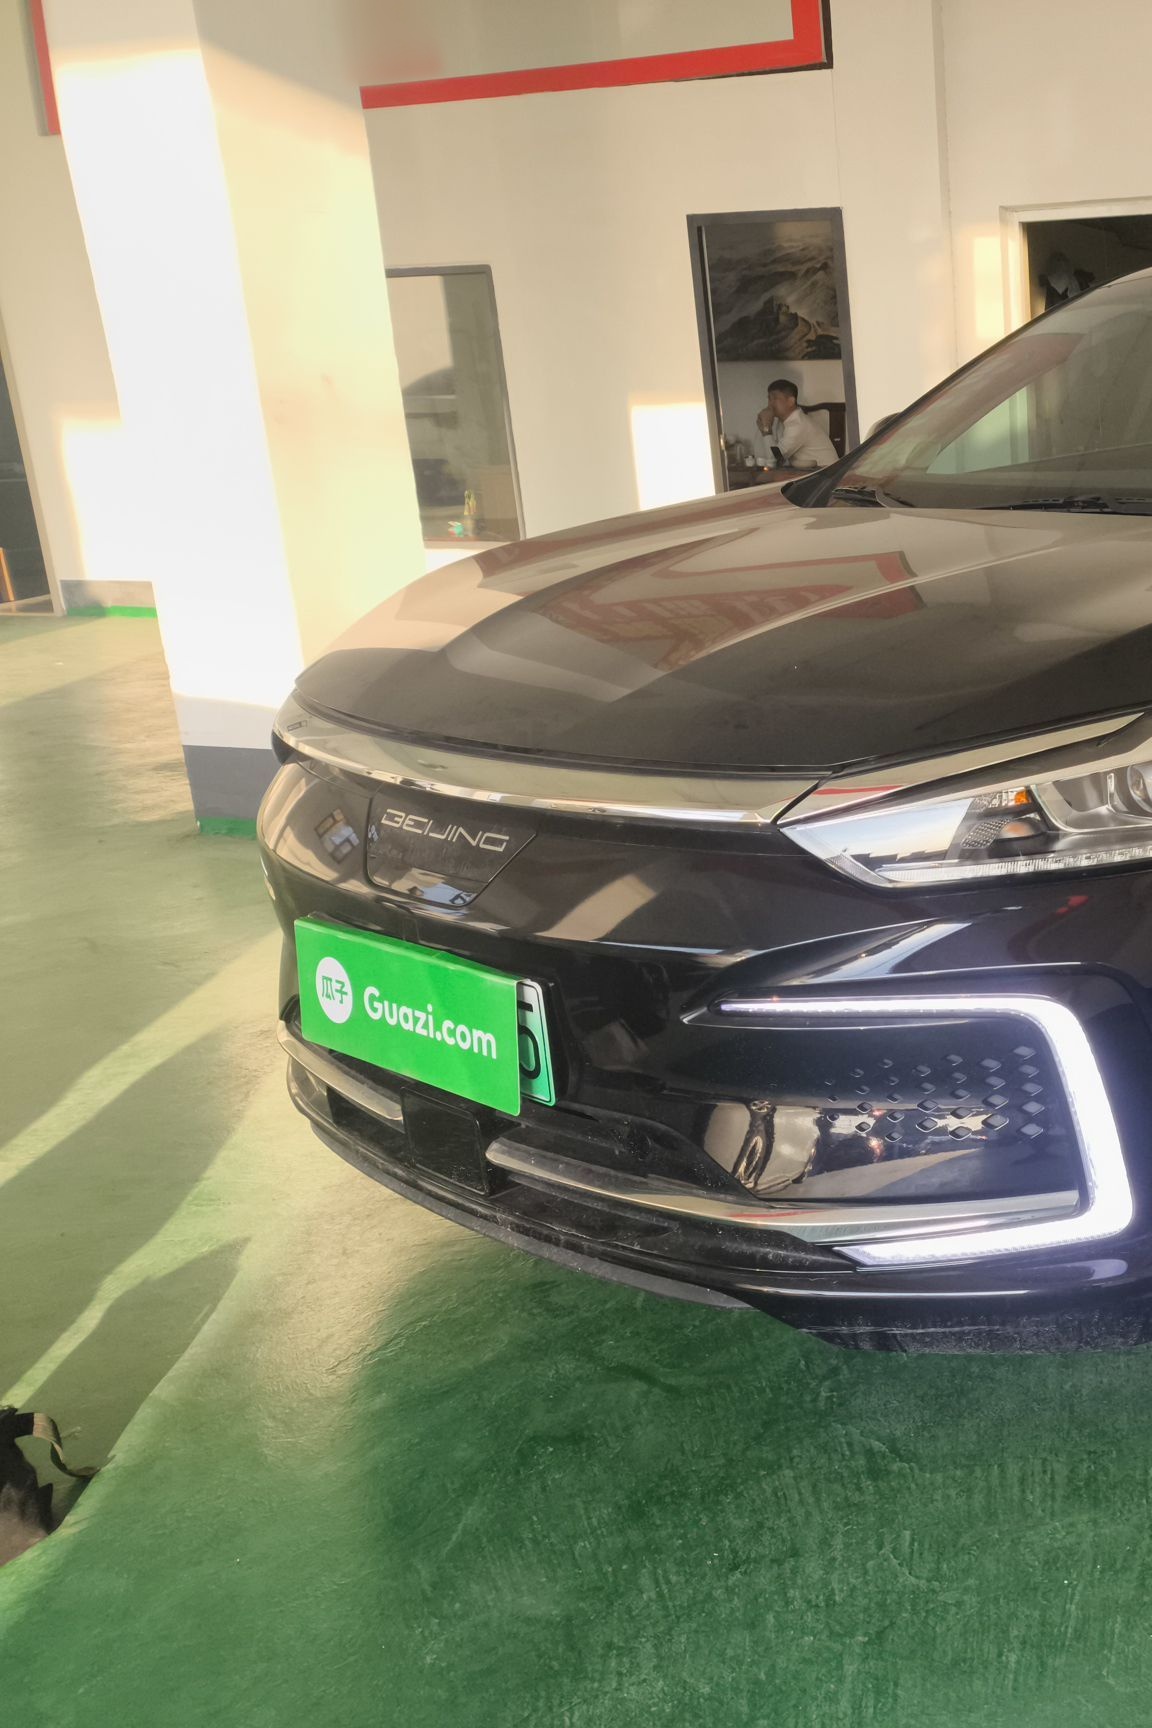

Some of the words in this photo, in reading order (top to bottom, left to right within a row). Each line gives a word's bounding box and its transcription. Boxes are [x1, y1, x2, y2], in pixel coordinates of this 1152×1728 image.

[381, 808, 510, 852] BEIJING
[321, 975, 348, 1005] 瓜子
[363, 986, 497, 1060] Guazi.com
